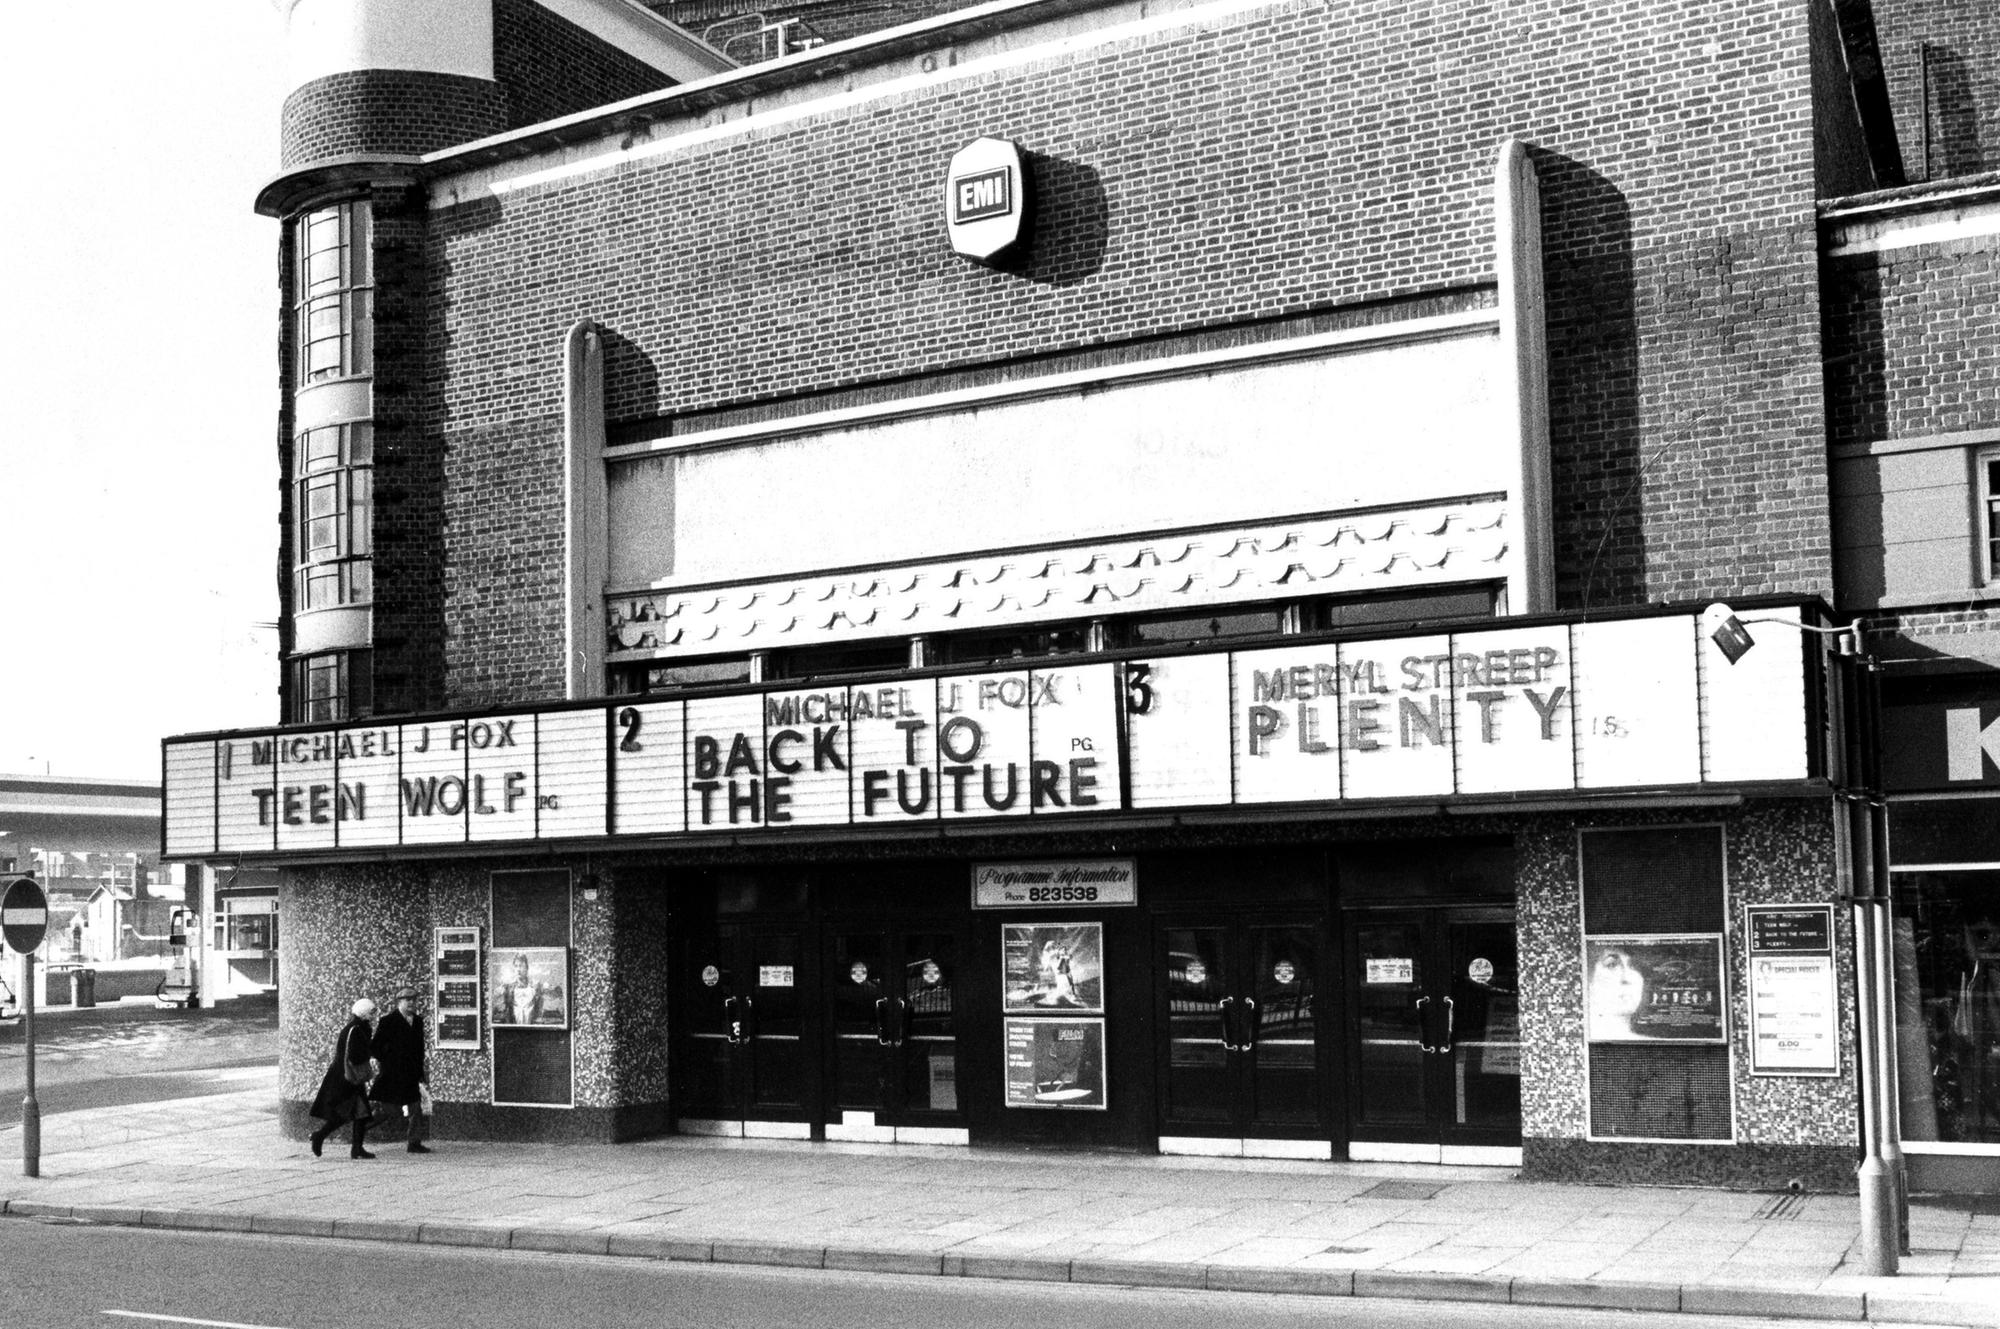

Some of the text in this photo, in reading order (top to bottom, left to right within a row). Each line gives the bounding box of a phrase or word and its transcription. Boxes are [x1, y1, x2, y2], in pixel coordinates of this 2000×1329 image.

[960, 177, 1002, 212] EMI
[1127, 663, 1151, 713] 3
[1253, 646, 1557, 702] MERYL STREEP
[768, 672, 1062, 725] MICHAEL J FOX
[1248, 686, 1567, 755] PLENTY
[252, 720, 515, 766] MICHAEL J FOX
[620, 707, 642, 751] 2
[695, 716, 982, 779] BACK TO
[1071, 737, 1092, 751] PG
[252, 772, 526, 826] TEEN WOLF
[692, 757, 1097, 824] THE FUTURE
[978, 866, 1130, 887] Programme Information
[1029, 887, 1098, 901] 823538
[1753, 931, 1760, 939] 2
[1754, 940, 1760, 949] 3
